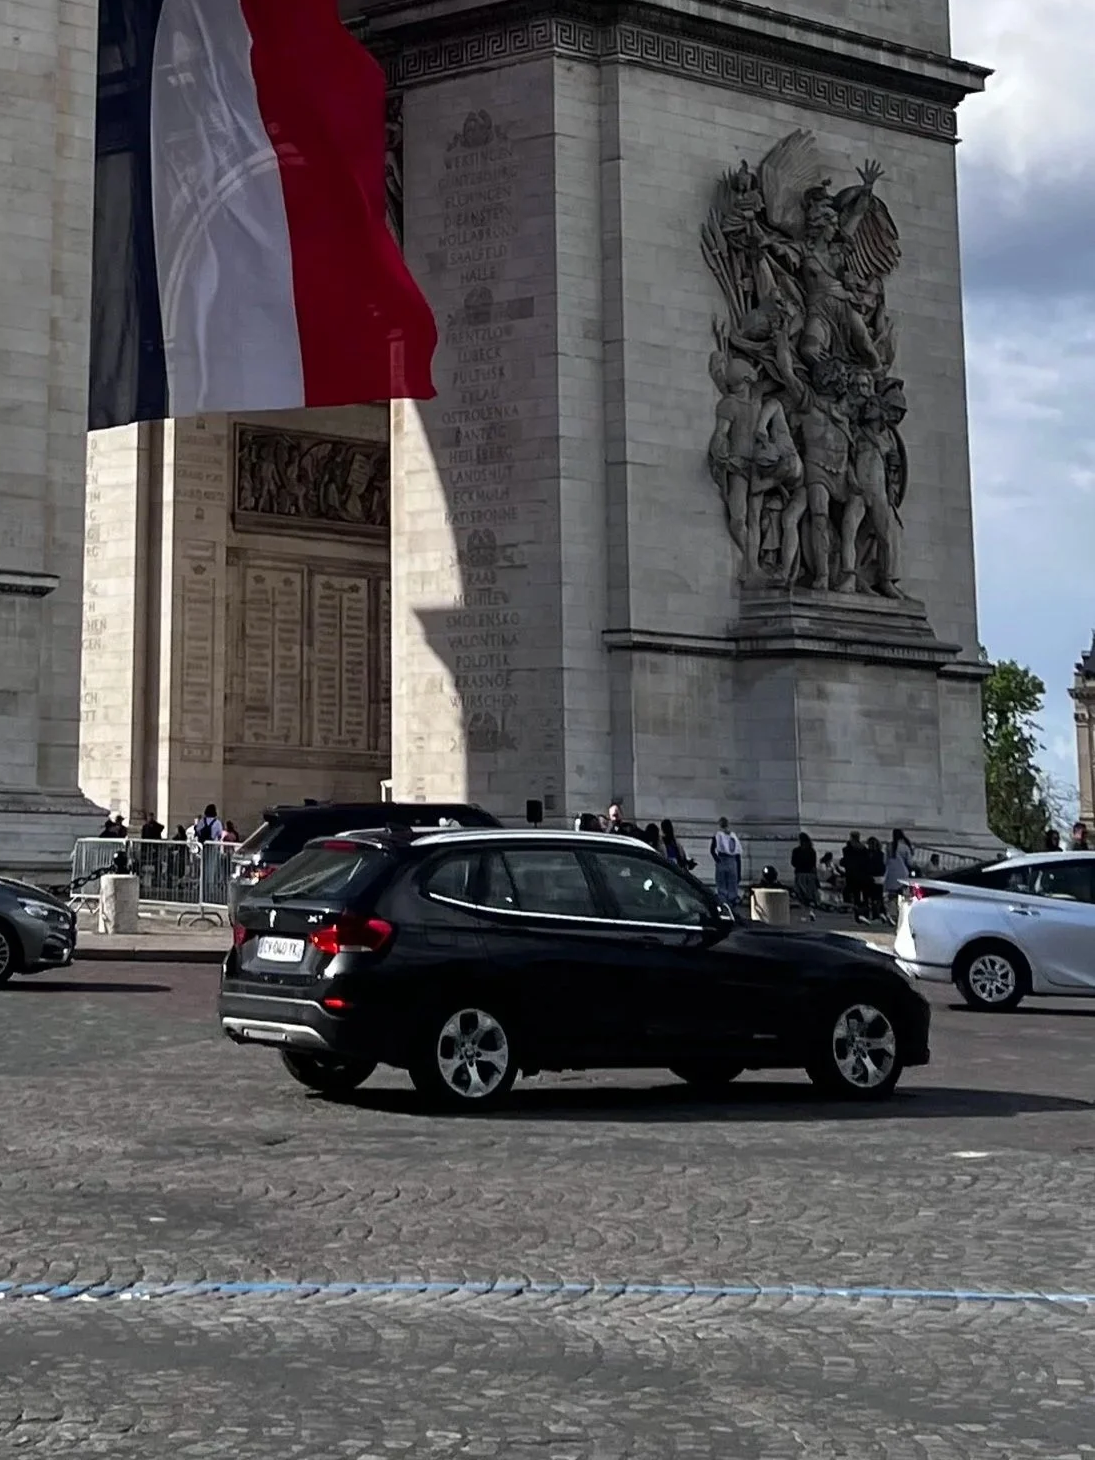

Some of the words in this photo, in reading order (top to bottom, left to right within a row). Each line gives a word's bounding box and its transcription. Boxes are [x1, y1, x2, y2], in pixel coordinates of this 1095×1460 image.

[460, 266, 496, 284] HALLE
[466, 570, 497, 586] RAAB
[445, 612, 520, 628] SMOLENSKO
